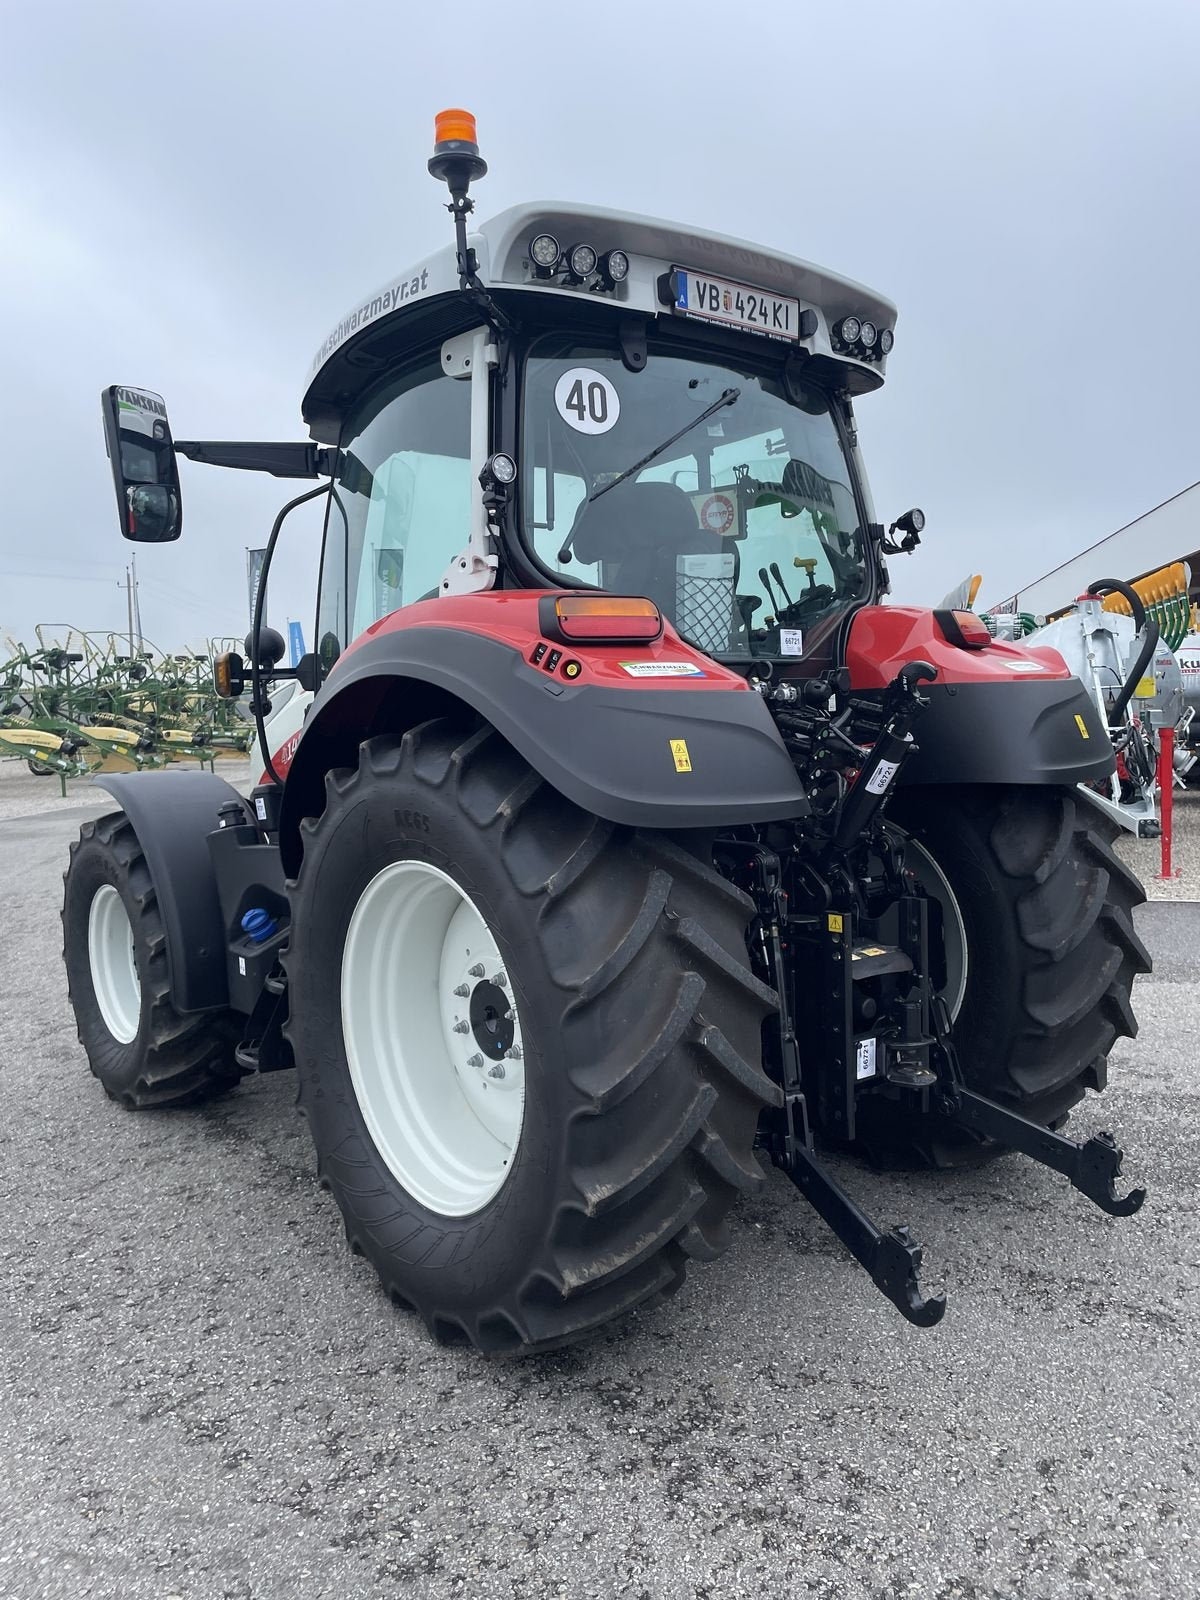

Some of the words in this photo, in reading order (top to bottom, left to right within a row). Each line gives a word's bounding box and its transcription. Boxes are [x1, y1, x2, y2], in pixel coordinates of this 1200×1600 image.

[679, 294, 686, 304] A
[695, 280, 720, 312] VB
[565, 379, 608, 424] 40
[877, 766, 894, 788] 66721
